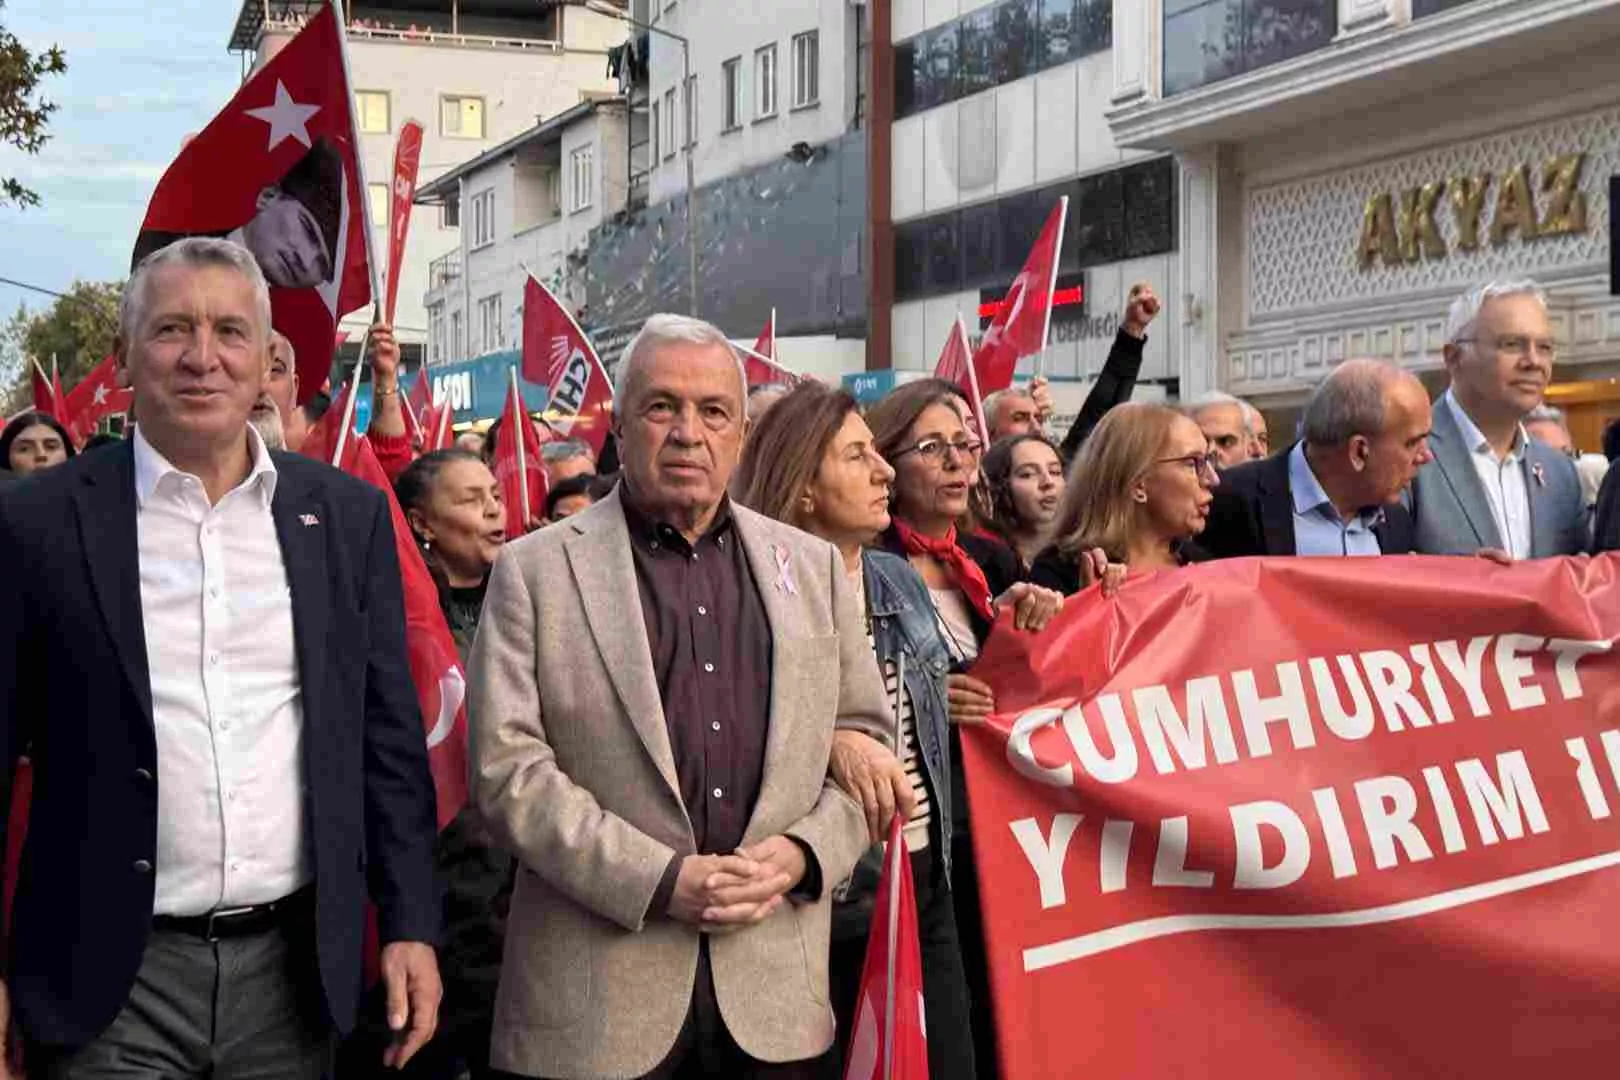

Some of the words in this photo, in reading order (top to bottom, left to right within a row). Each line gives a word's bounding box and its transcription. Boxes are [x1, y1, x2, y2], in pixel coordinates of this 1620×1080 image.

[1358, 153, 1587, 272] AKYAZ
[1006, 633, 1613, 787] CUMHURİYET
[1009, 750, 1551, 910] YILDIRIM
